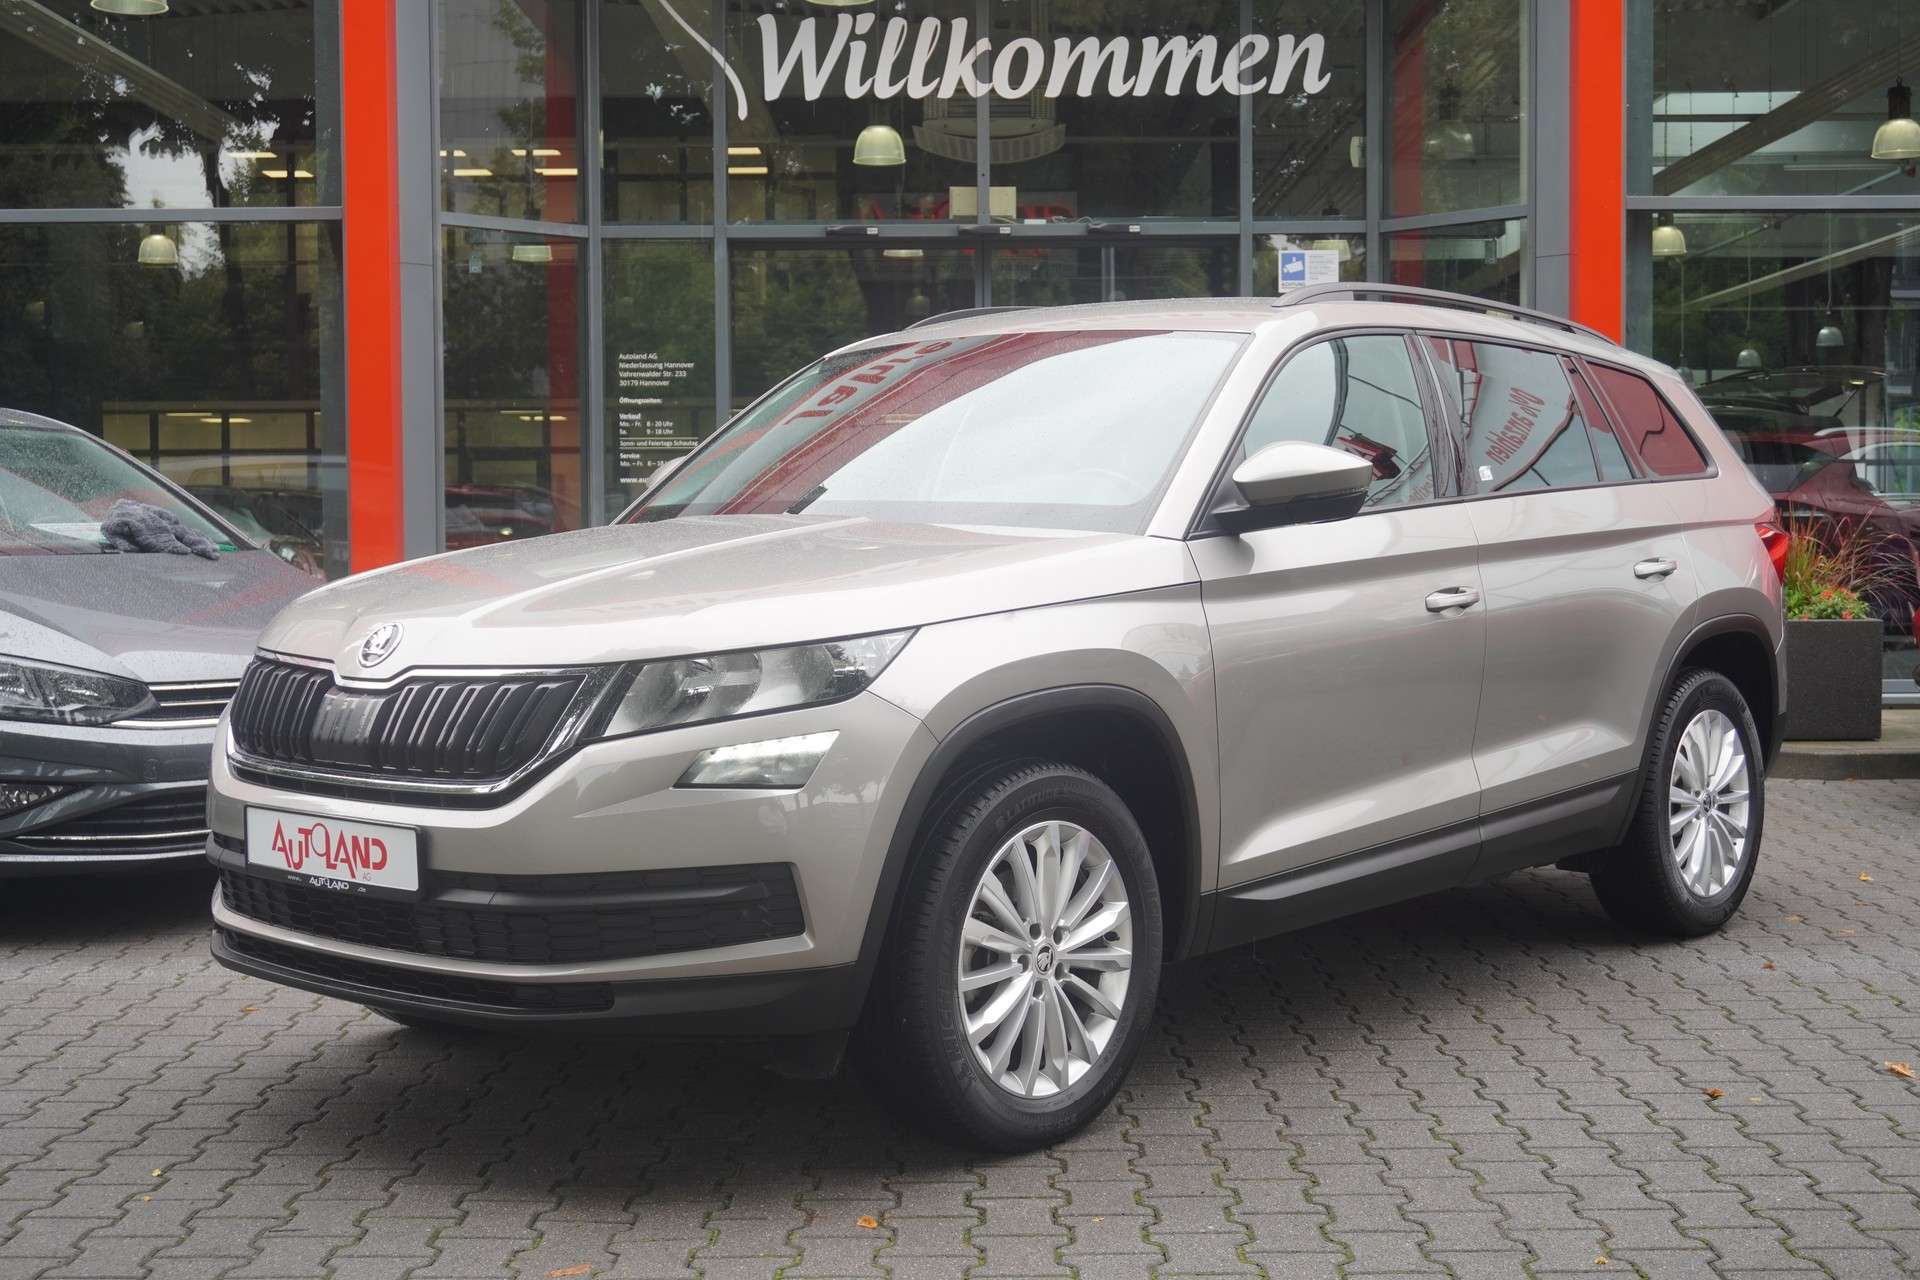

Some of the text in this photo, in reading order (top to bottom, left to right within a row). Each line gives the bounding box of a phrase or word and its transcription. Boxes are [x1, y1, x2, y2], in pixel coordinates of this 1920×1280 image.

[757, 12, 1331, 101] Willkommen
[619, 362, 663, 370] Niederlassung
[272, 818, 388, 880] AUTOLAND
[309, 876, 350, 891] AUTOLAND
[363, 872, 372, 882] AG
